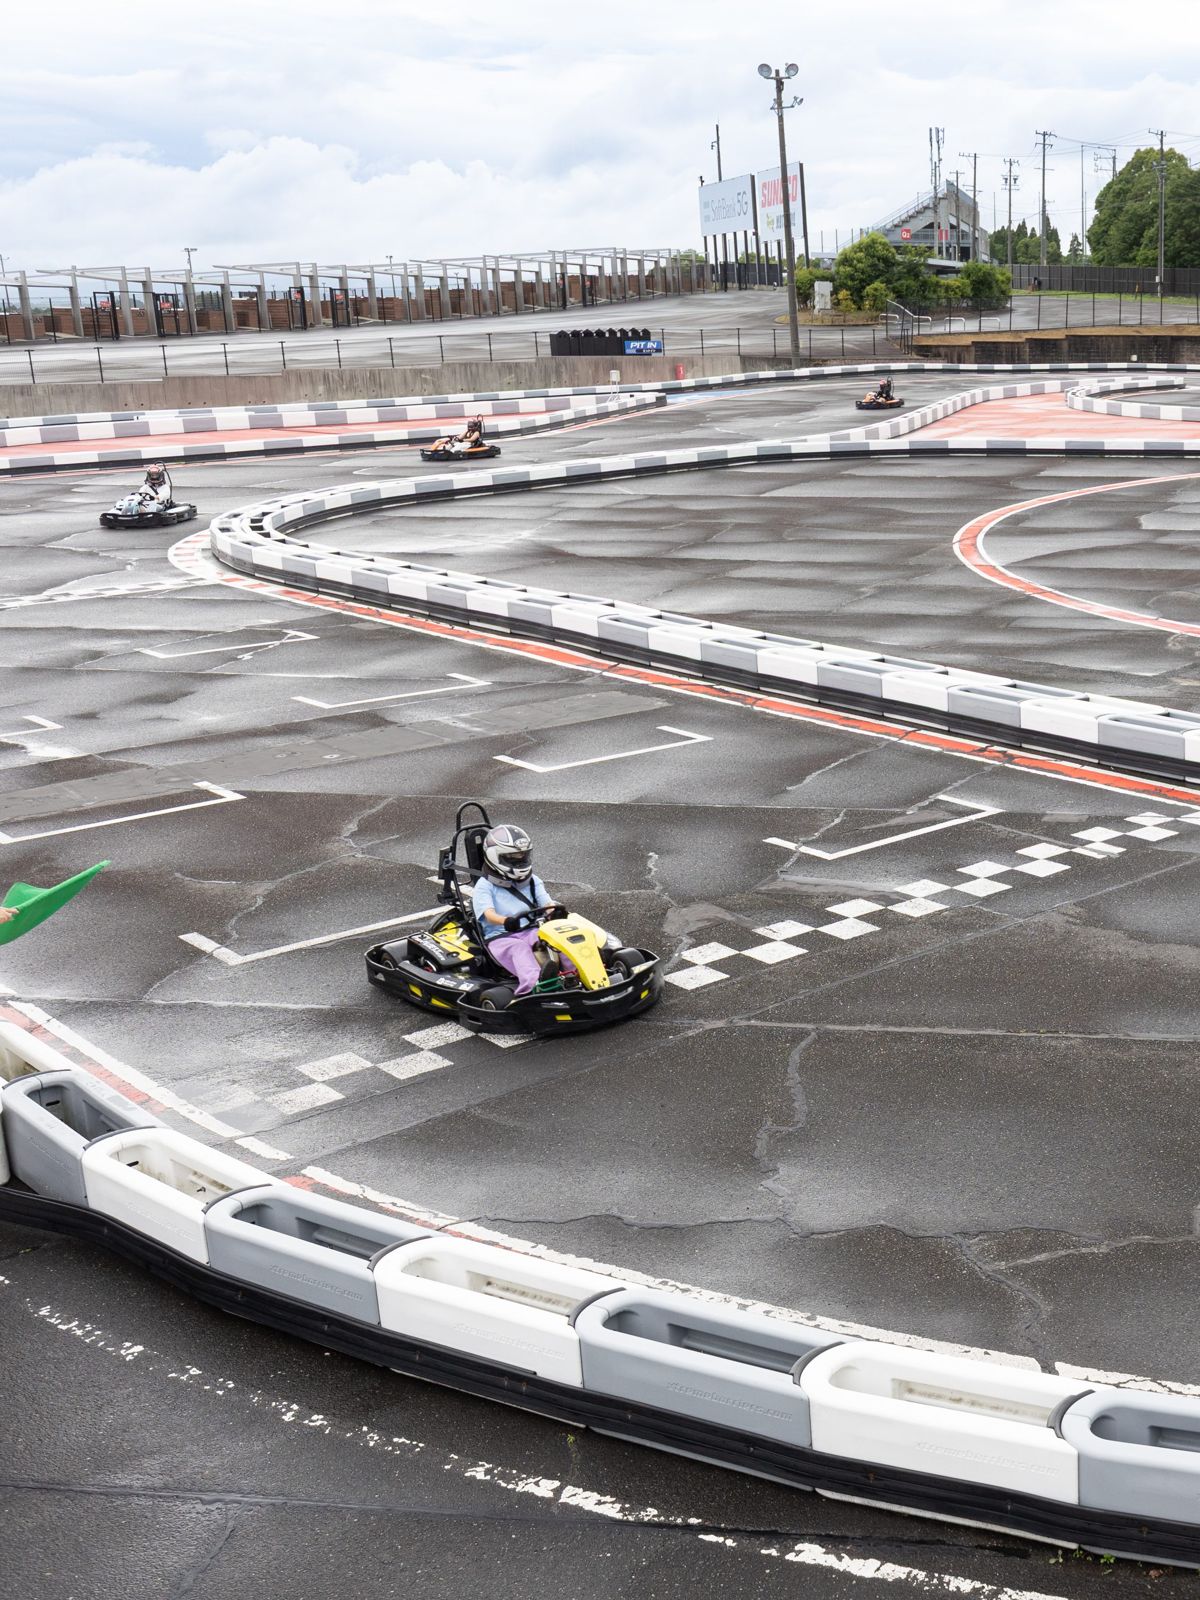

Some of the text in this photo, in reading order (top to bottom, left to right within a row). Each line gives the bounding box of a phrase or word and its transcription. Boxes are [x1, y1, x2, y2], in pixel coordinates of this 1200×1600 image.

[737, 190, 748, 216] 5G
[630, 341, 657, 349] PIT IN
